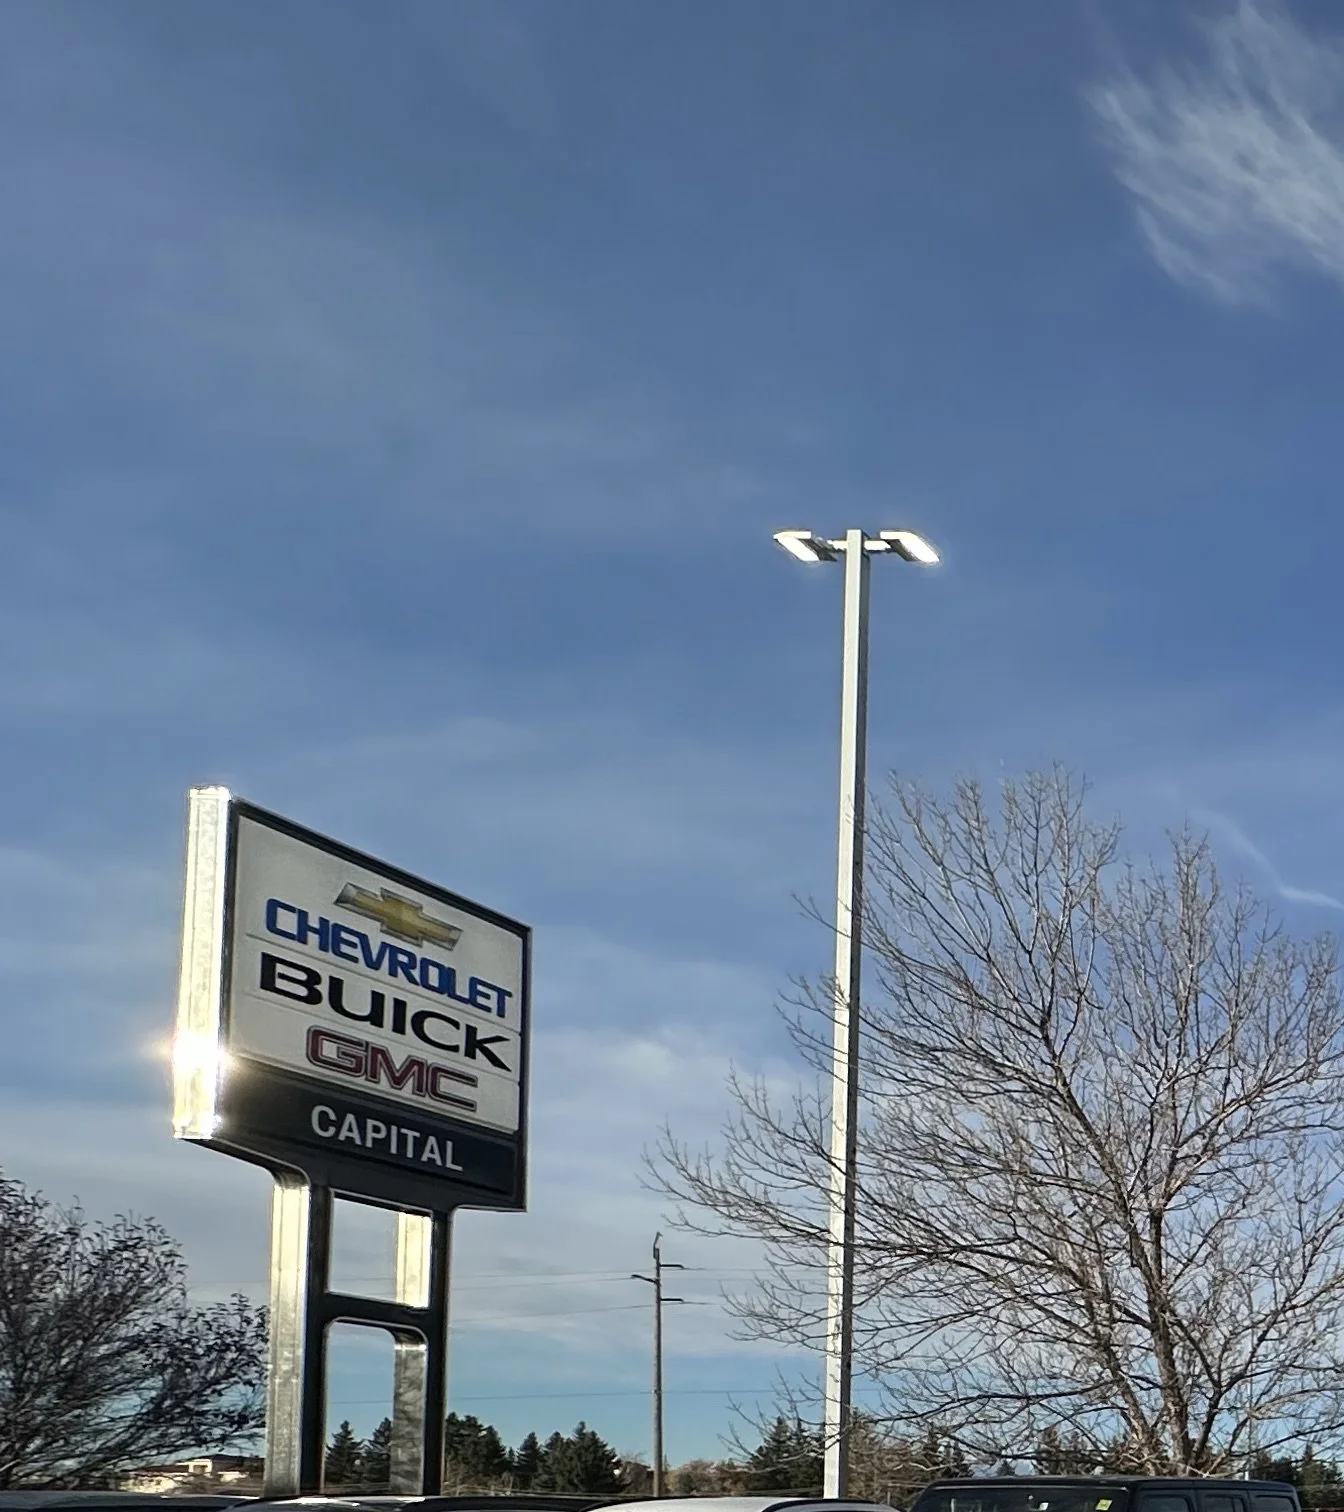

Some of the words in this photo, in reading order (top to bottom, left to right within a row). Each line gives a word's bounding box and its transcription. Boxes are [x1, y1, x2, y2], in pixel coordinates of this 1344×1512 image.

[266, 898, 512, 1018] CHEVROLET
[260, 952, 512, 1071] BUICK
[306, 1026, 478, 1112] GMC
[311, 1105, 464, 1172] CAPITAL
